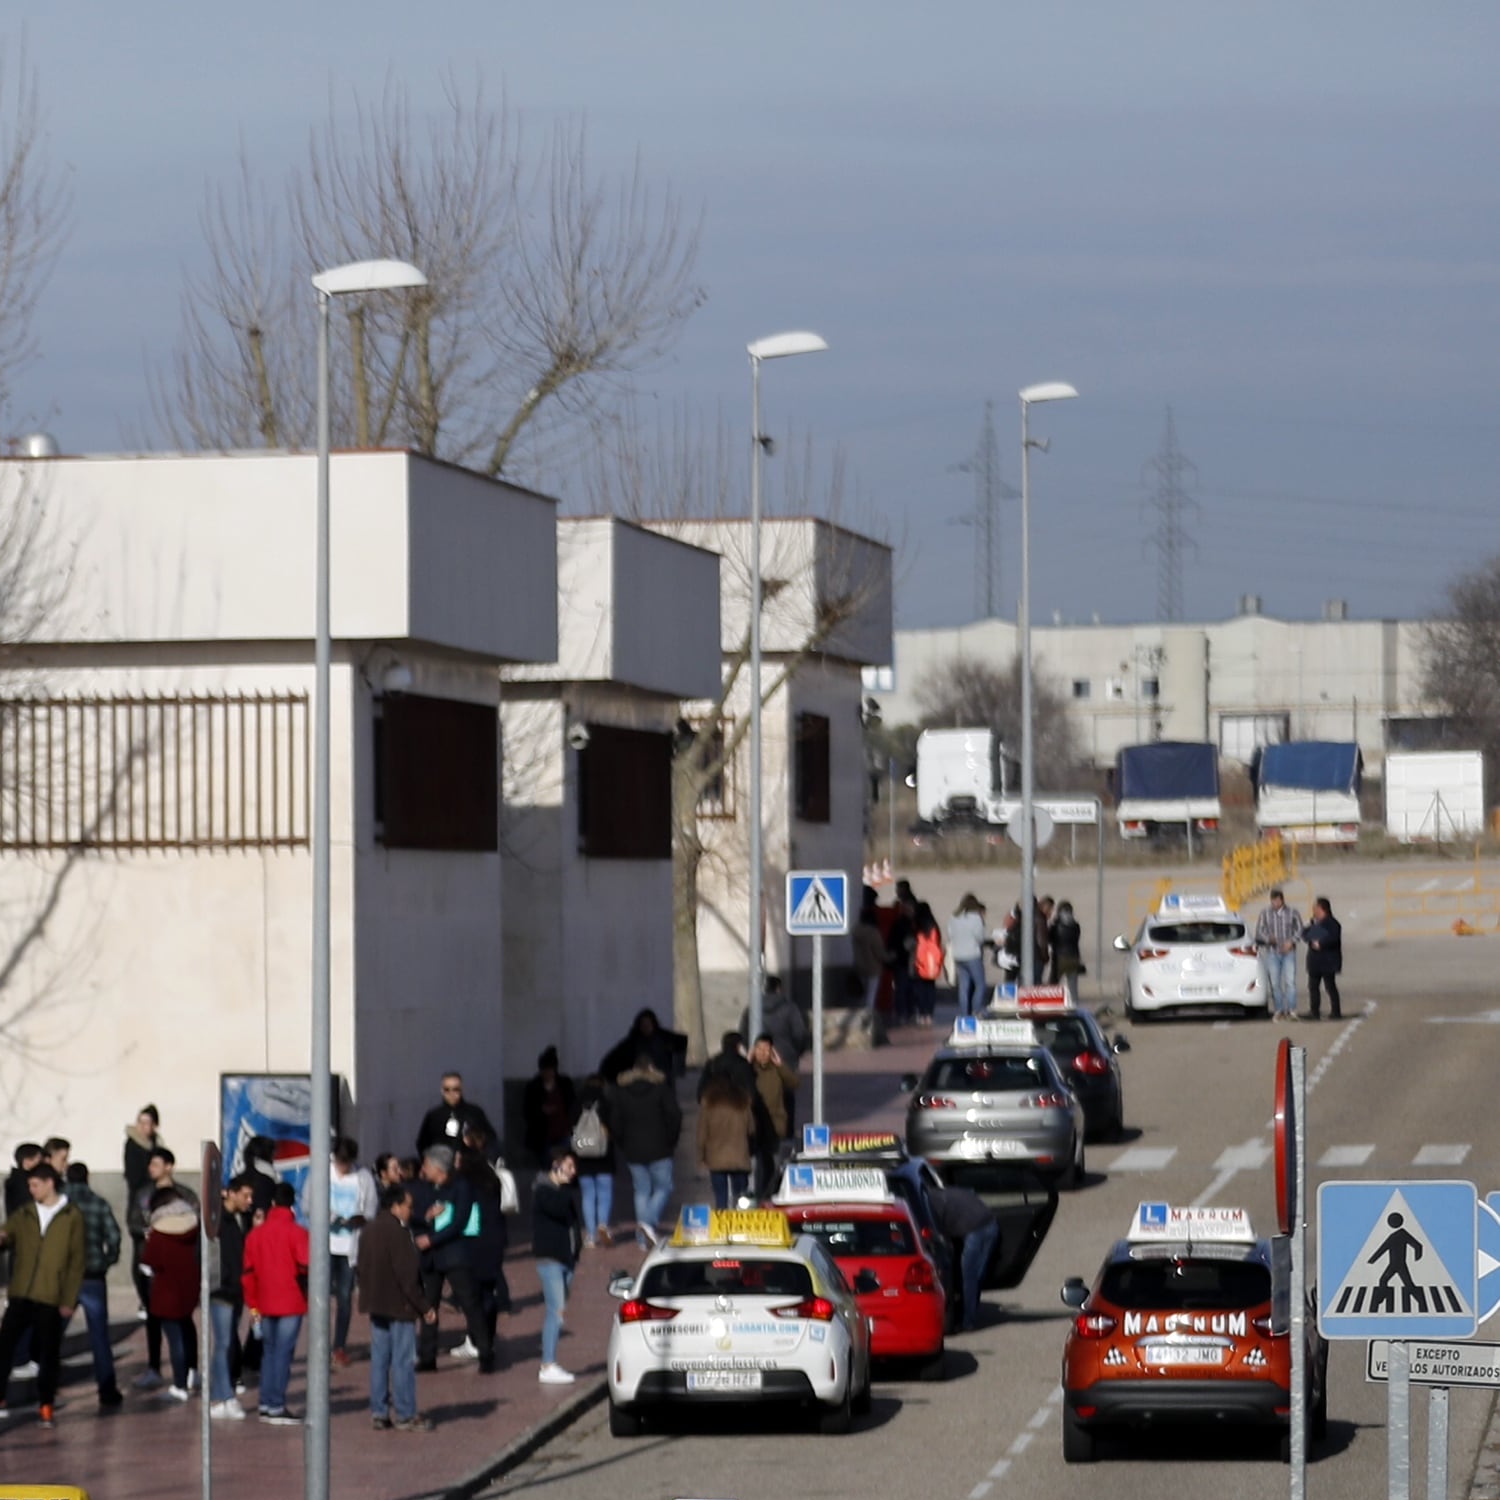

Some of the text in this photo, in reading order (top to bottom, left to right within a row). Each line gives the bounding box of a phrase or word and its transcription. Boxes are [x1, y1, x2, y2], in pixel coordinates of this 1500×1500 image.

[1146, 1204, 1160, 1222] L
[1416, 1348, 1461, 1361] EXCEPTO
[1375, 1361, 1500, 1379] VELOS AUTORIZADOS
